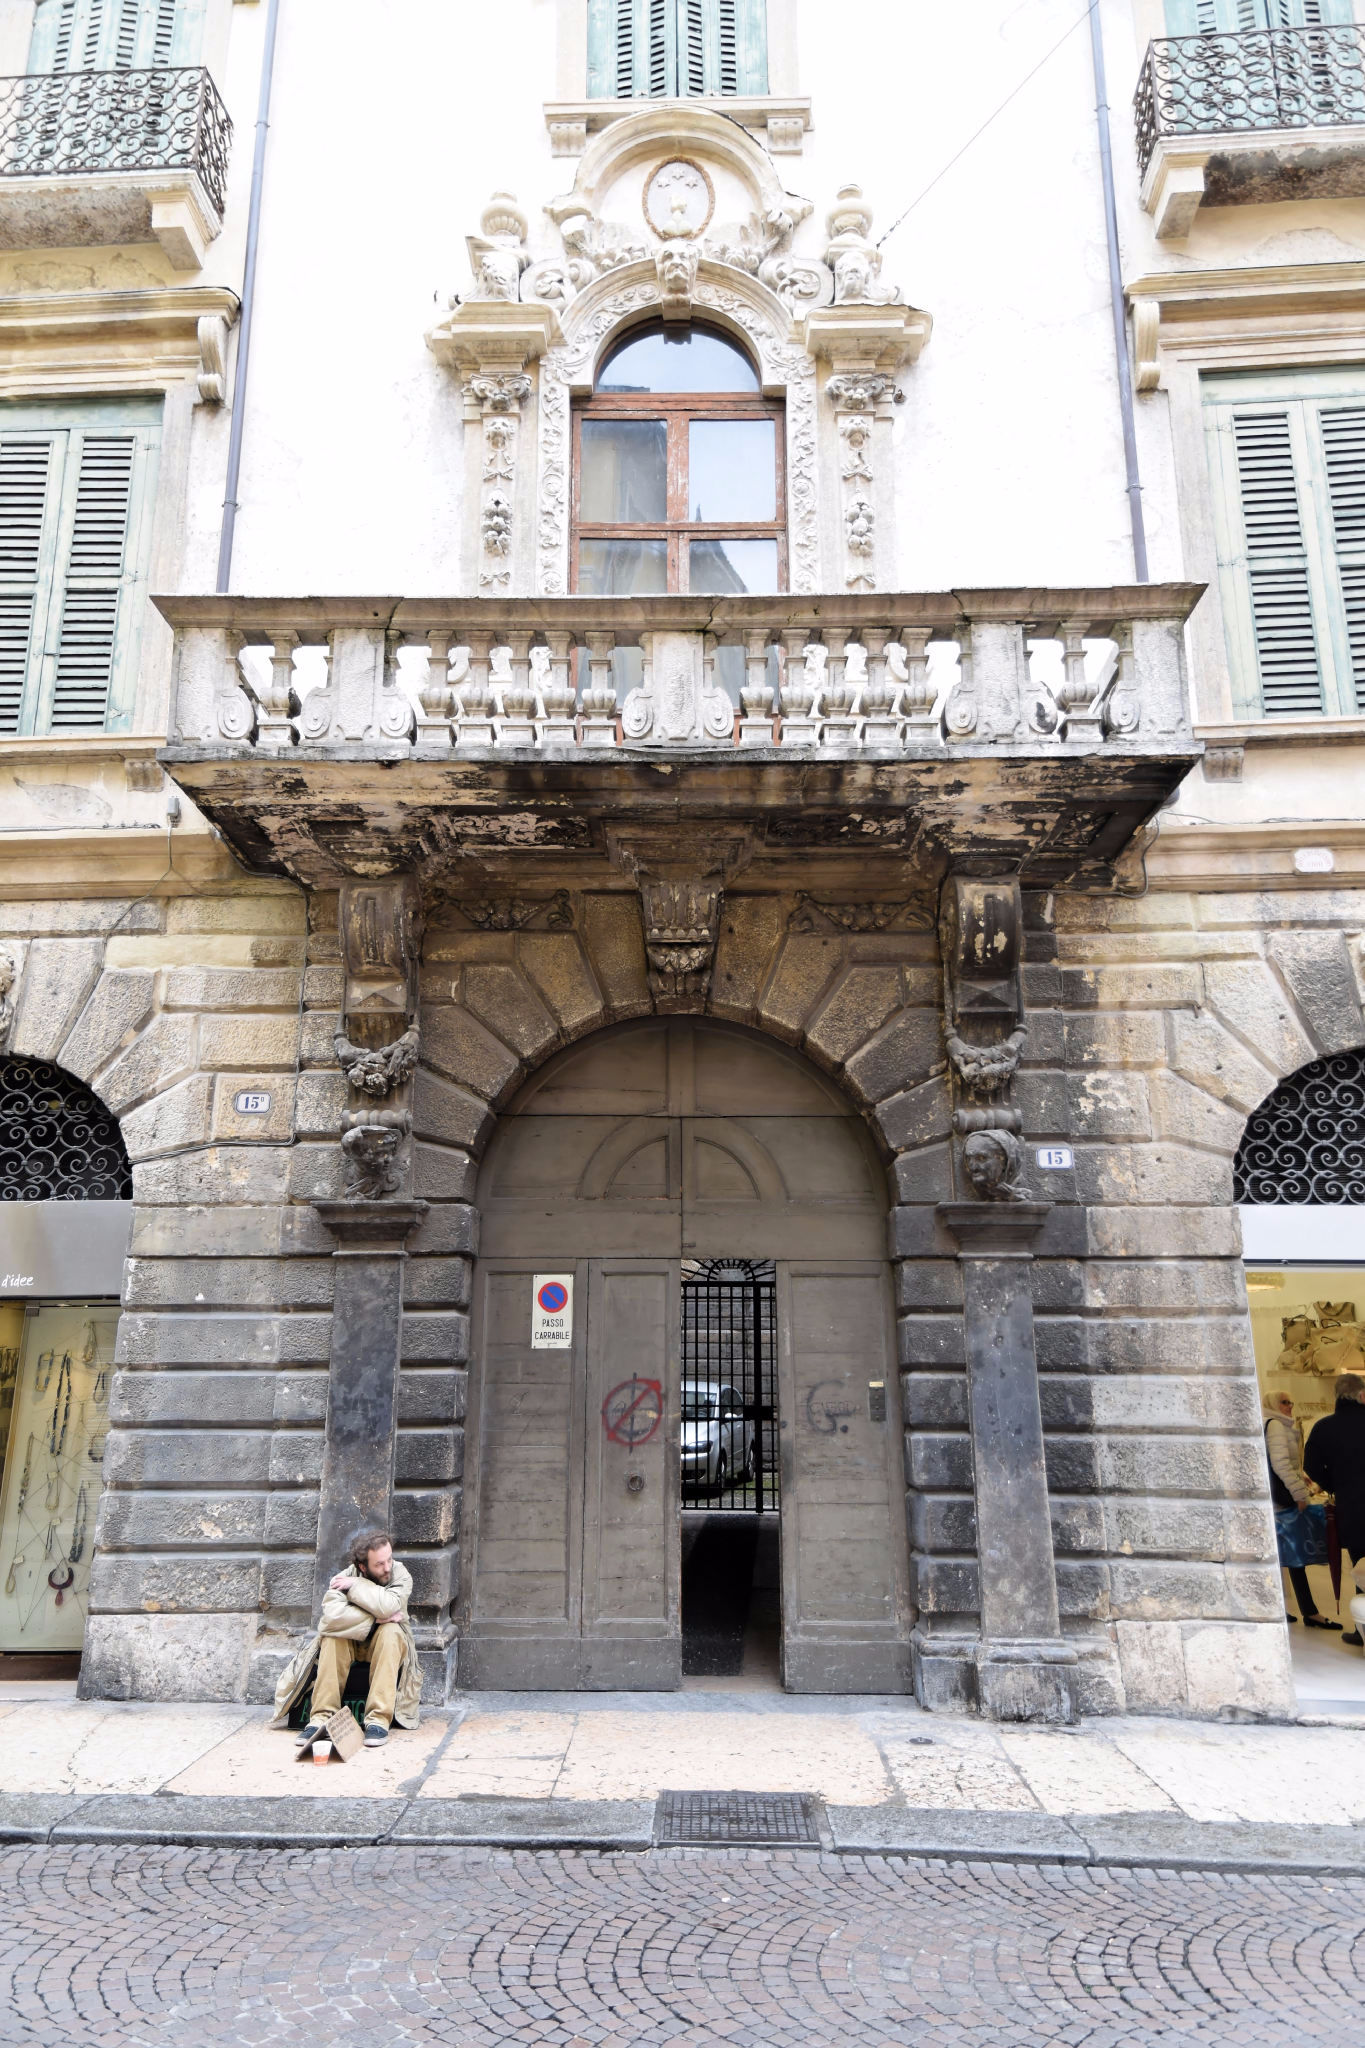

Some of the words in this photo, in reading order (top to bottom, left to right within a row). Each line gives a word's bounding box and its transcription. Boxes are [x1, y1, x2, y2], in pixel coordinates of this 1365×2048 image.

[1047, 1151, 1063, 1165] 15
[1, 1273, 34, 1288] d'idee
[542, 1318, 564, 1327] PASSO
[534, 1331, 570, 1340] CARRABILE
